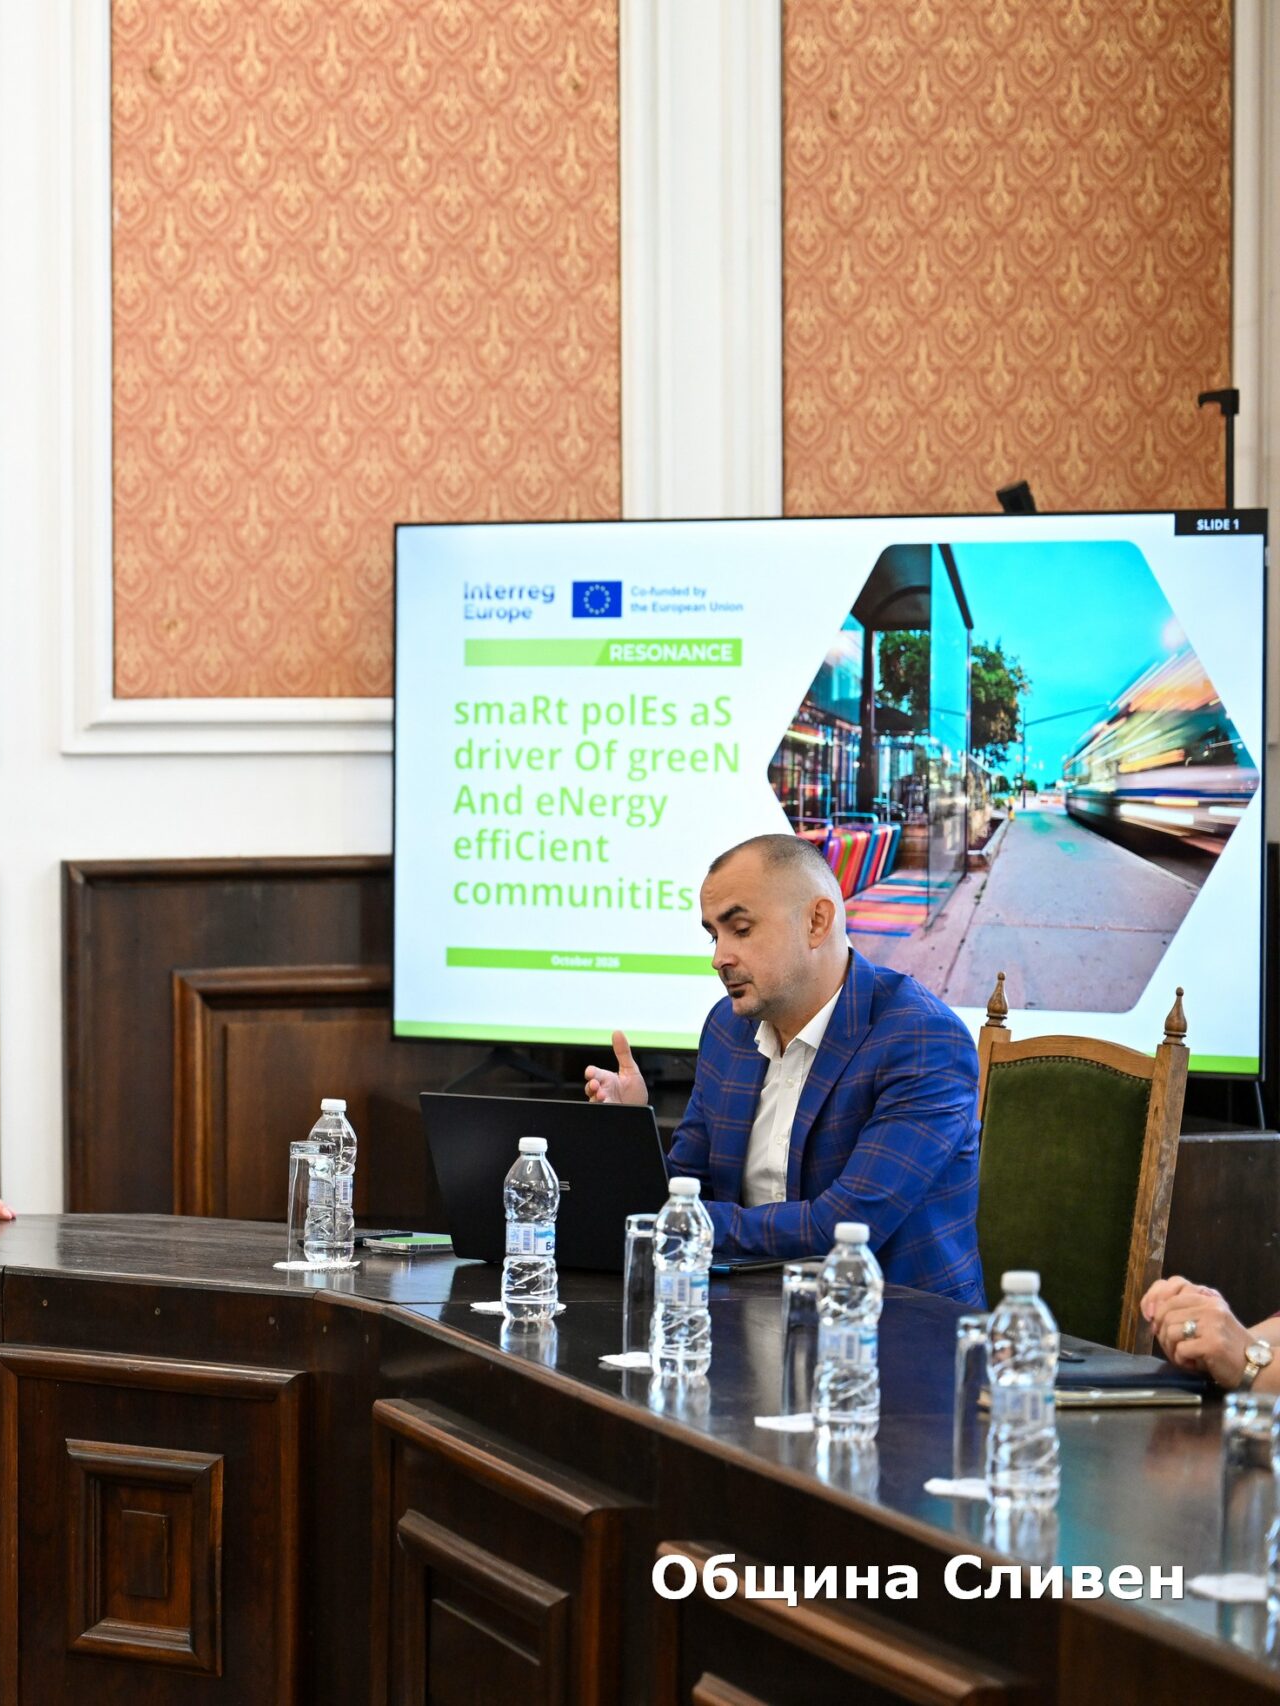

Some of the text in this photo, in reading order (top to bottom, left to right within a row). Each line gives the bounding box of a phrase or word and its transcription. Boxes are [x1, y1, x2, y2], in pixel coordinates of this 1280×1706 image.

[1196, 518, 1240, 531] SLIDE 1
[464, 581, 555, 603] Interreg
[631, 585, 707, 598] Co-funded by
[464, 604, 534, 623] Europe
[631, 602, 745, 615] the European Union
[609, 643, 734, 662] RESONANCE
[455, 694, 732, 735] smaRt polEs aS
[454, 739, 739, 782] driver Of greeN
[453, 784, 668, 828] And eNergy
[454, 829, 610, 862] effiCient
[453, 878, 694, 911] communitiEs
